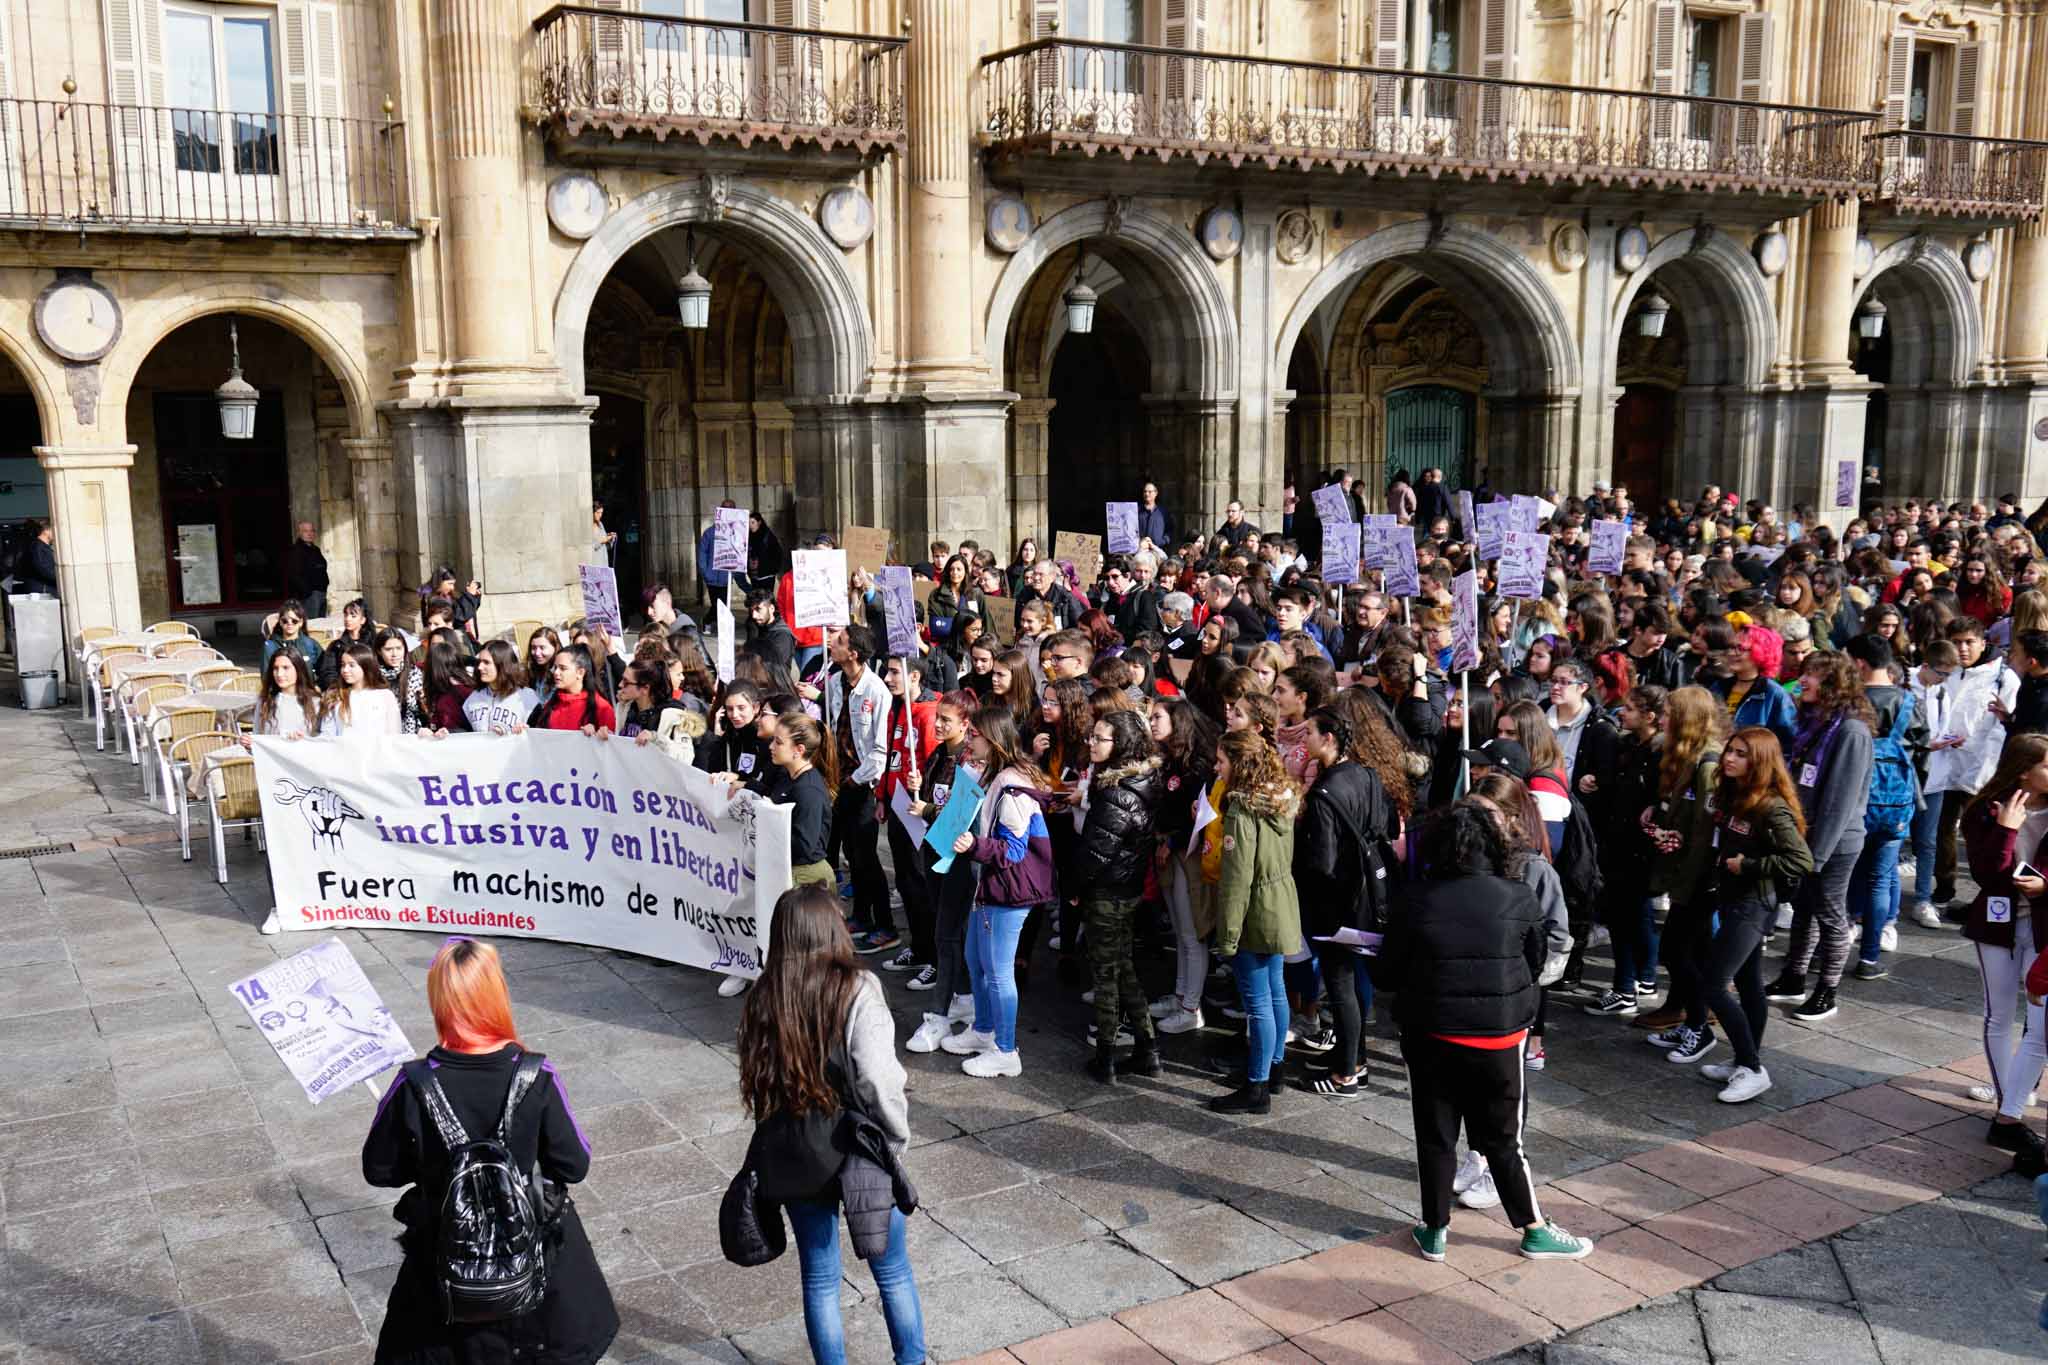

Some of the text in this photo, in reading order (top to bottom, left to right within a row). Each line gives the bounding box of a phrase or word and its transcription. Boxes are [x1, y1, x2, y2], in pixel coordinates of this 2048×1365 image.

[419, 768, 618, 815] Educación
[376, 813, 740, 896] inclusiva y en libertad
[301, 906, 537, 931] Sindicato de Estudiantes
[318, 869, 758, 938] Fuera machismo de nuestros
[235, 978, 269, 1006] 14
